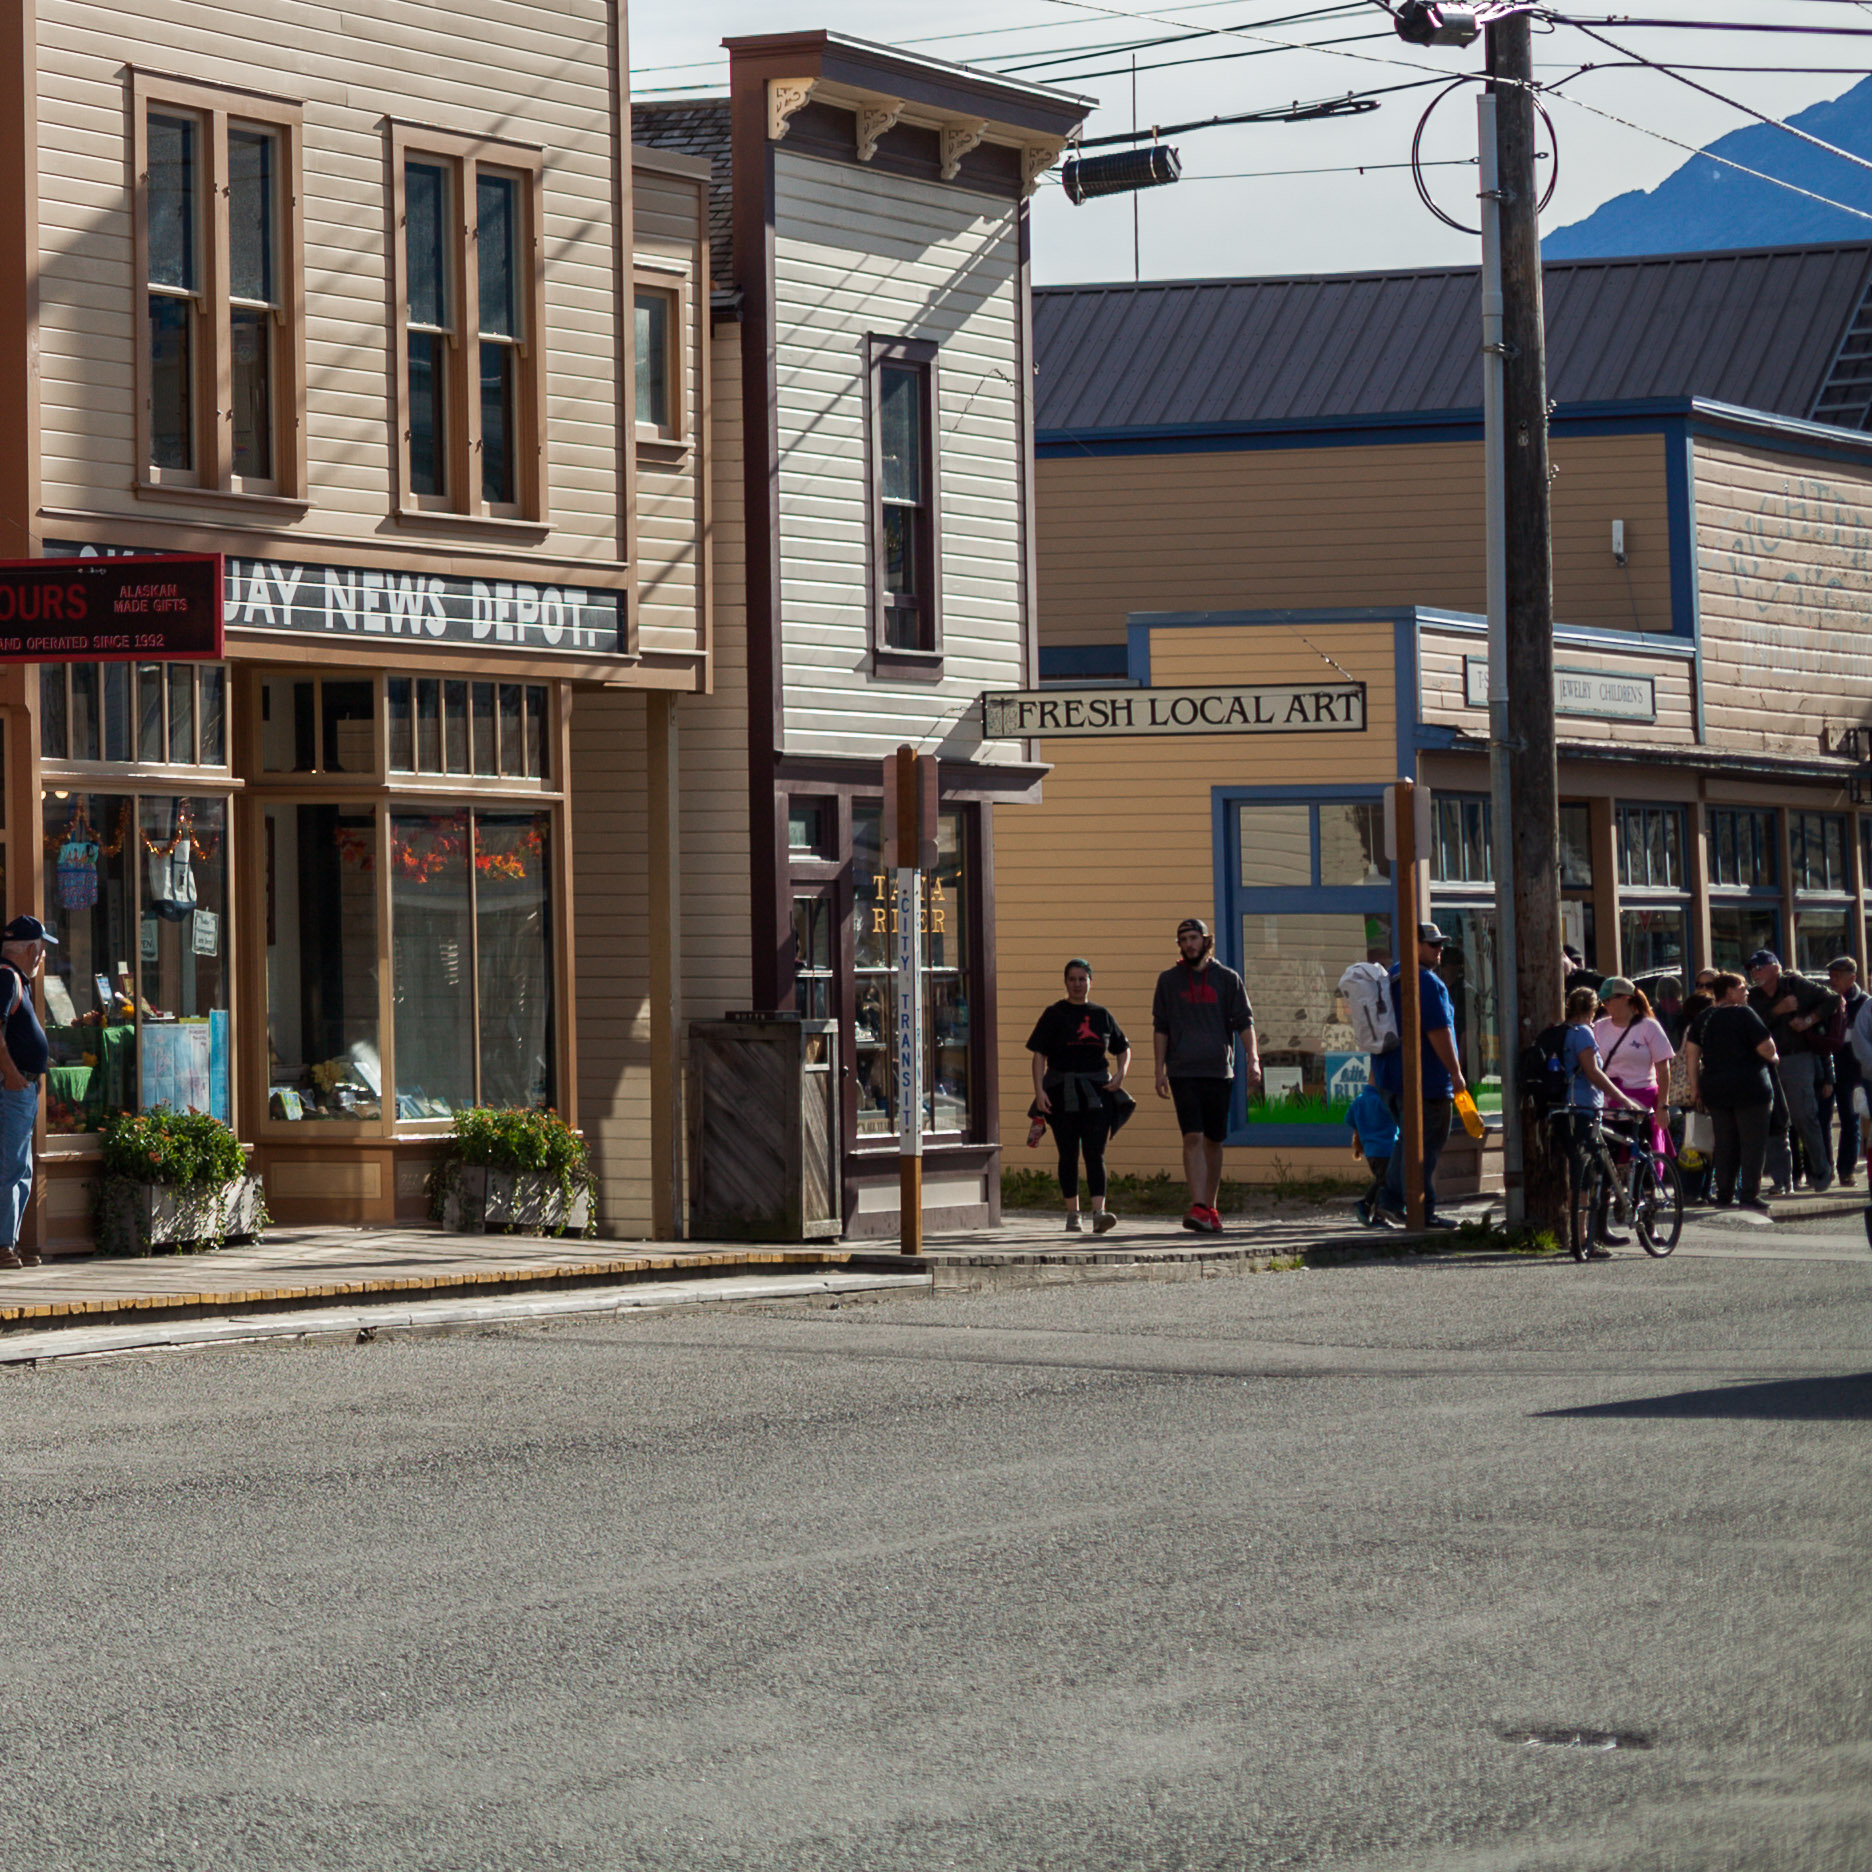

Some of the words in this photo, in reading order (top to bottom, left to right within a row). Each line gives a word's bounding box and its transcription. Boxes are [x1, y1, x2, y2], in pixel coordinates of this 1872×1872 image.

[120, 584, 178, 598] ALASKAN
[324, 568, 446, 637] NEWS
[114, 599, 148, 613] MADE
[153, 598, 188, 612] GIFTS
[26, 635, 87, 651] OPERATED
[93, 635, 129, 649] SINCE
[135, 634, 165, 648] 1992
[1560, 679, 1592, 700] JEWELRY
[1600, 683, 1643, 704] CHILDREN'S
[1017, 698, 1134, 728] FRESH
[1149, 696, 1276, 726] LOCAL
[1283, 693, 1361, 724] ART
[872, 908, 946, 933] RIER
[901, 898, 910, 971] CITY
[901, 994, 910, 1126] TRANSIT
